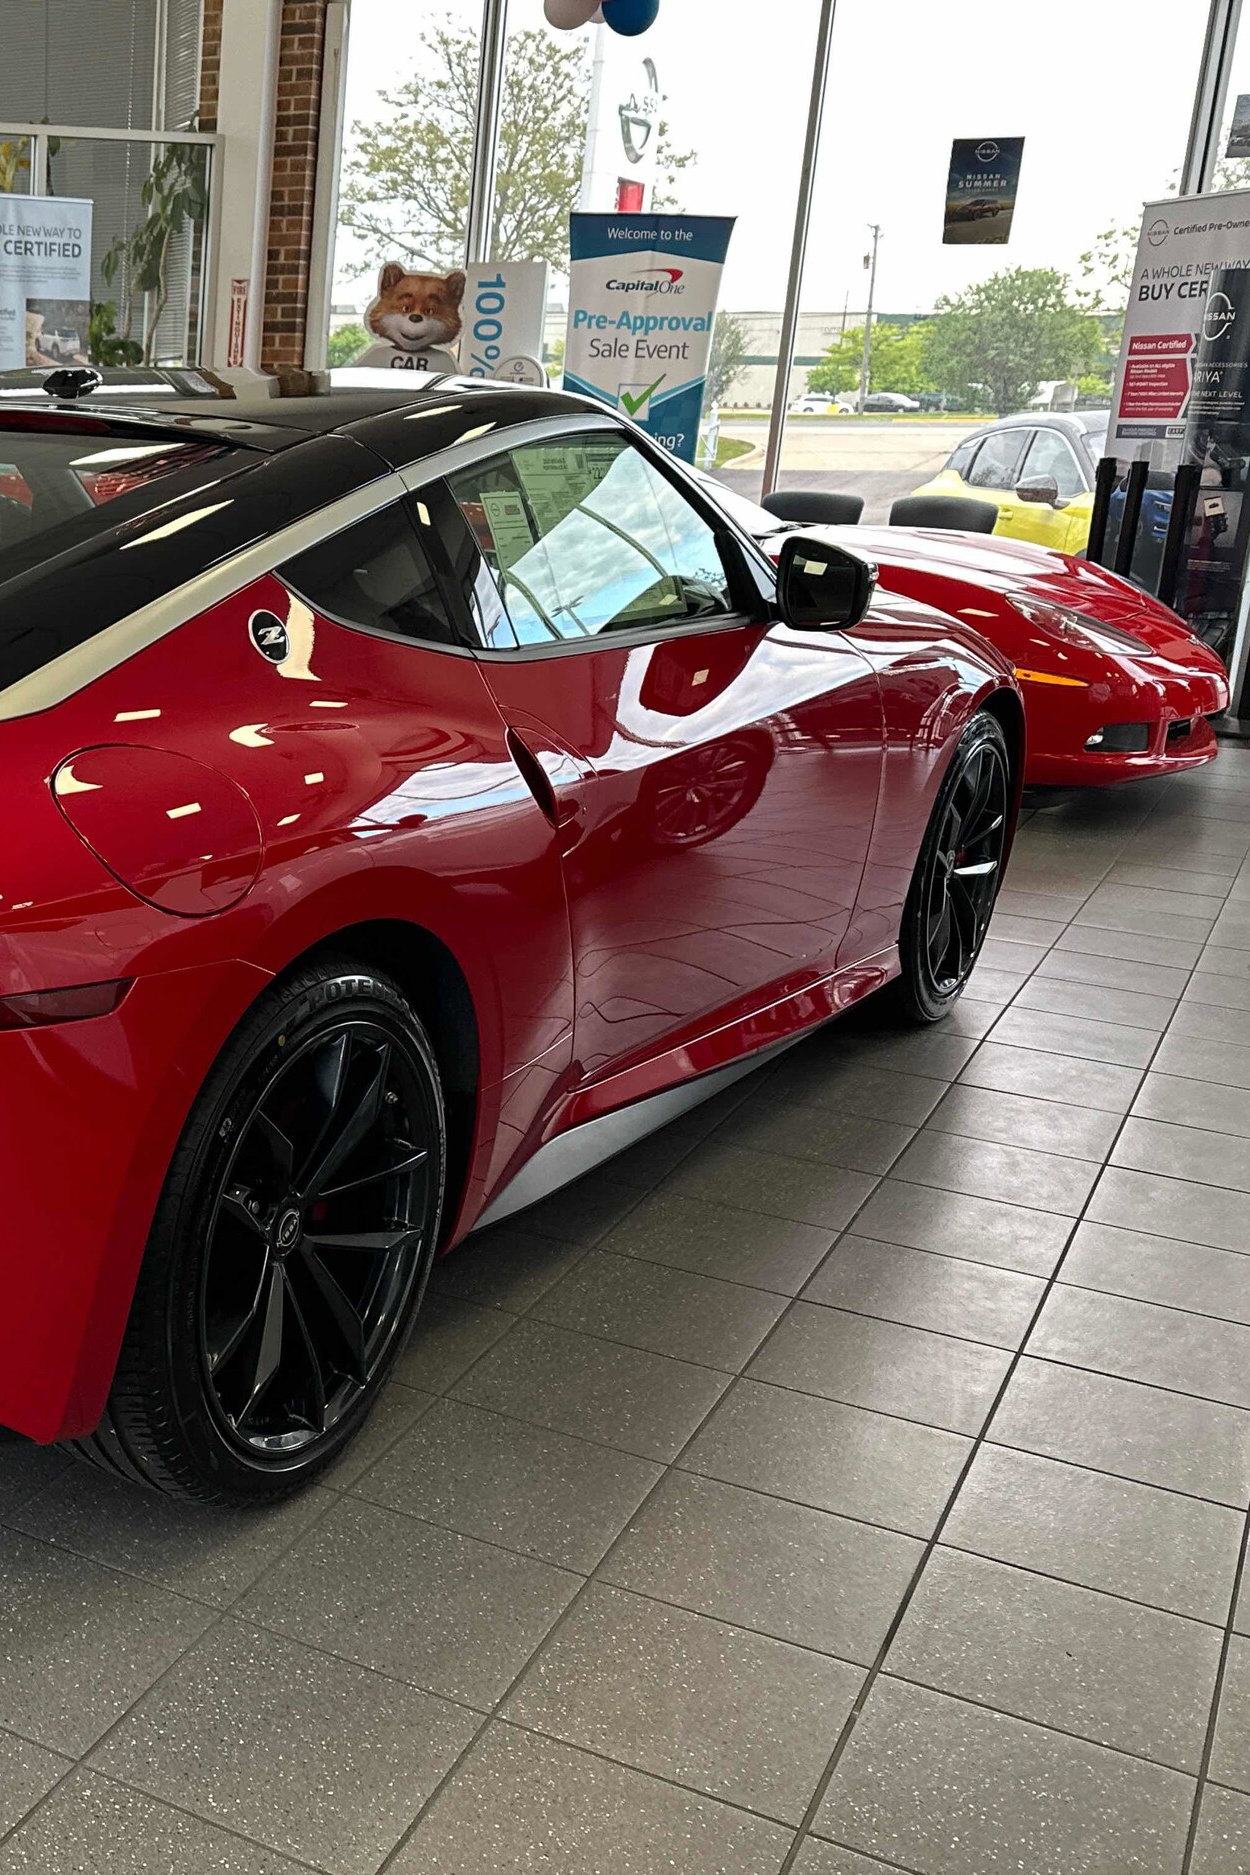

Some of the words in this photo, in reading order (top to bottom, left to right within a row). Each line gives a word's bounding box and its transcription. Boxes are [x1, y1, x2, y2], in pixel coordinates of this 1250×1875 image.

[958, 180, 1007, 188] SUMMER
[16, 225, 43, 237] NEW
[43, 226, 65, 238] WAY
[67, 227, 82, 239] TO
[607, 227, 657, 240] Welcome
[660, 230, 672, 241] to
[674, 229, 693, 241] the
[1173, 223, 1208, 235] Certified
[3, 240, 82, 258] CERTIFIED
[1140, 268, 1149, 280] A
[1152, 264, 1193, 280] WHOLE
[1195, 261, 1222, 276] NEW
[1138, 282, 1175, 301] BUY
[1177, 280, 1209, 299] CER
[573, 309, 713, 336] Pre-Approval
[588, 337, 630, 359] Sale
[634, 339, 690, 360] Event
[1132, 342, 1157, 351] Nissan
[1157, 340, 1187, 350] Certified
[1218, 391, 1243, 399] LEVEL
